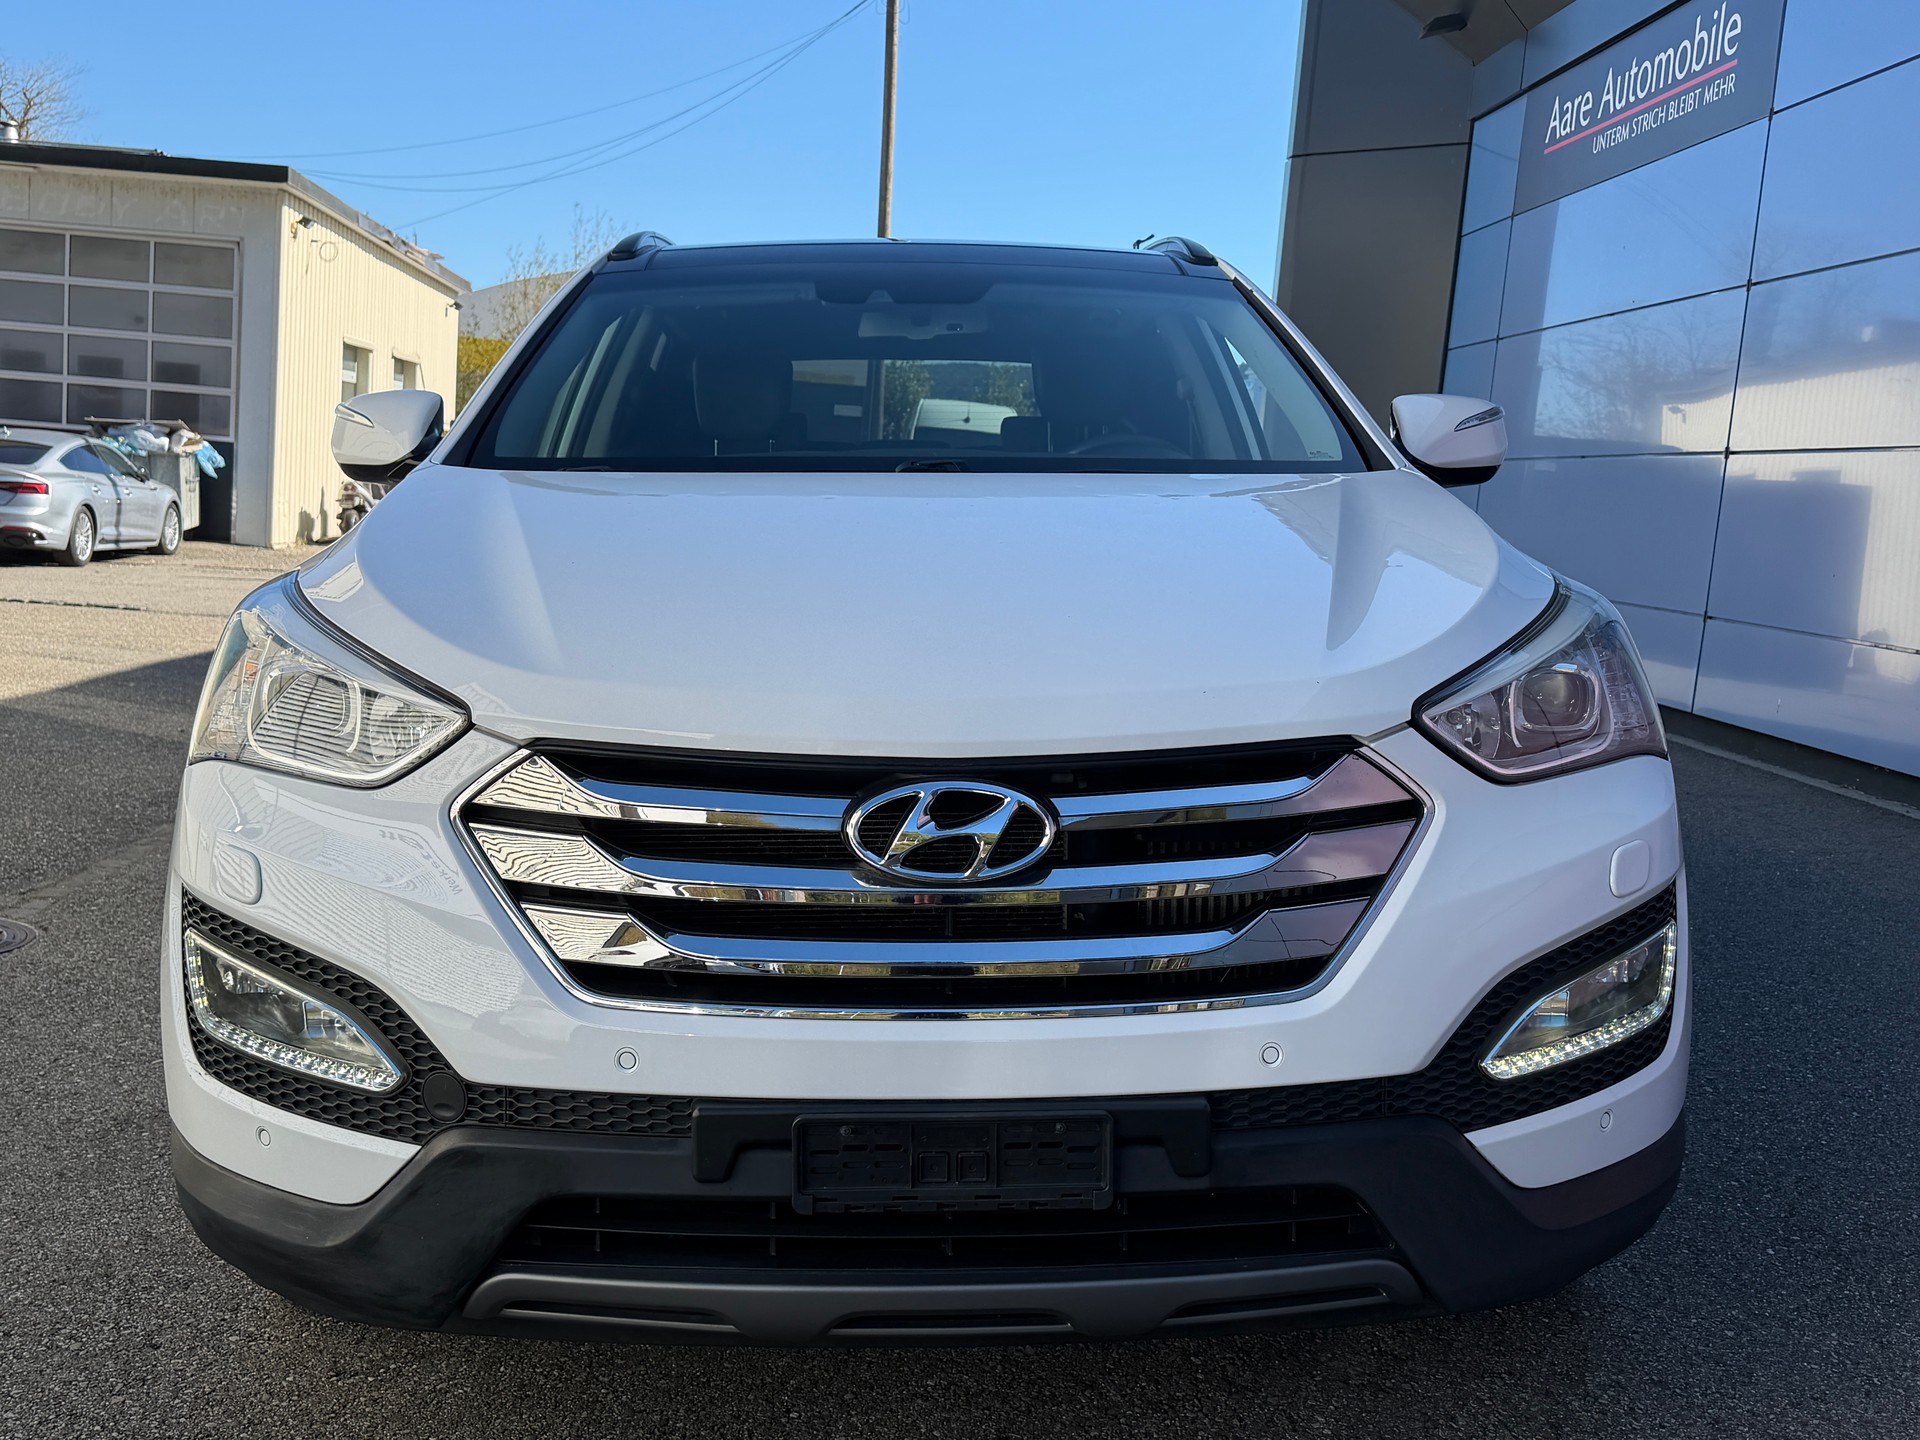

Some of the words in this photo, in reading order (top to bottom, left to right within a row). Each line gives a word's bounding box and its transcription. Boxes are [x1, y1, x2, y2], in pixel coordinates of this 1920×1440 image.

[1545, 90, 1593, 143] Aare
[1598, 1, 1742, 119] Automobile
[1592, 125, 1630, 154] UNTERM
[1631, 107, 1667, 137] STRICH
[1668, 88, 1702, 121] BLEIBT
[1703, 73, 1736, 105] MEHR
